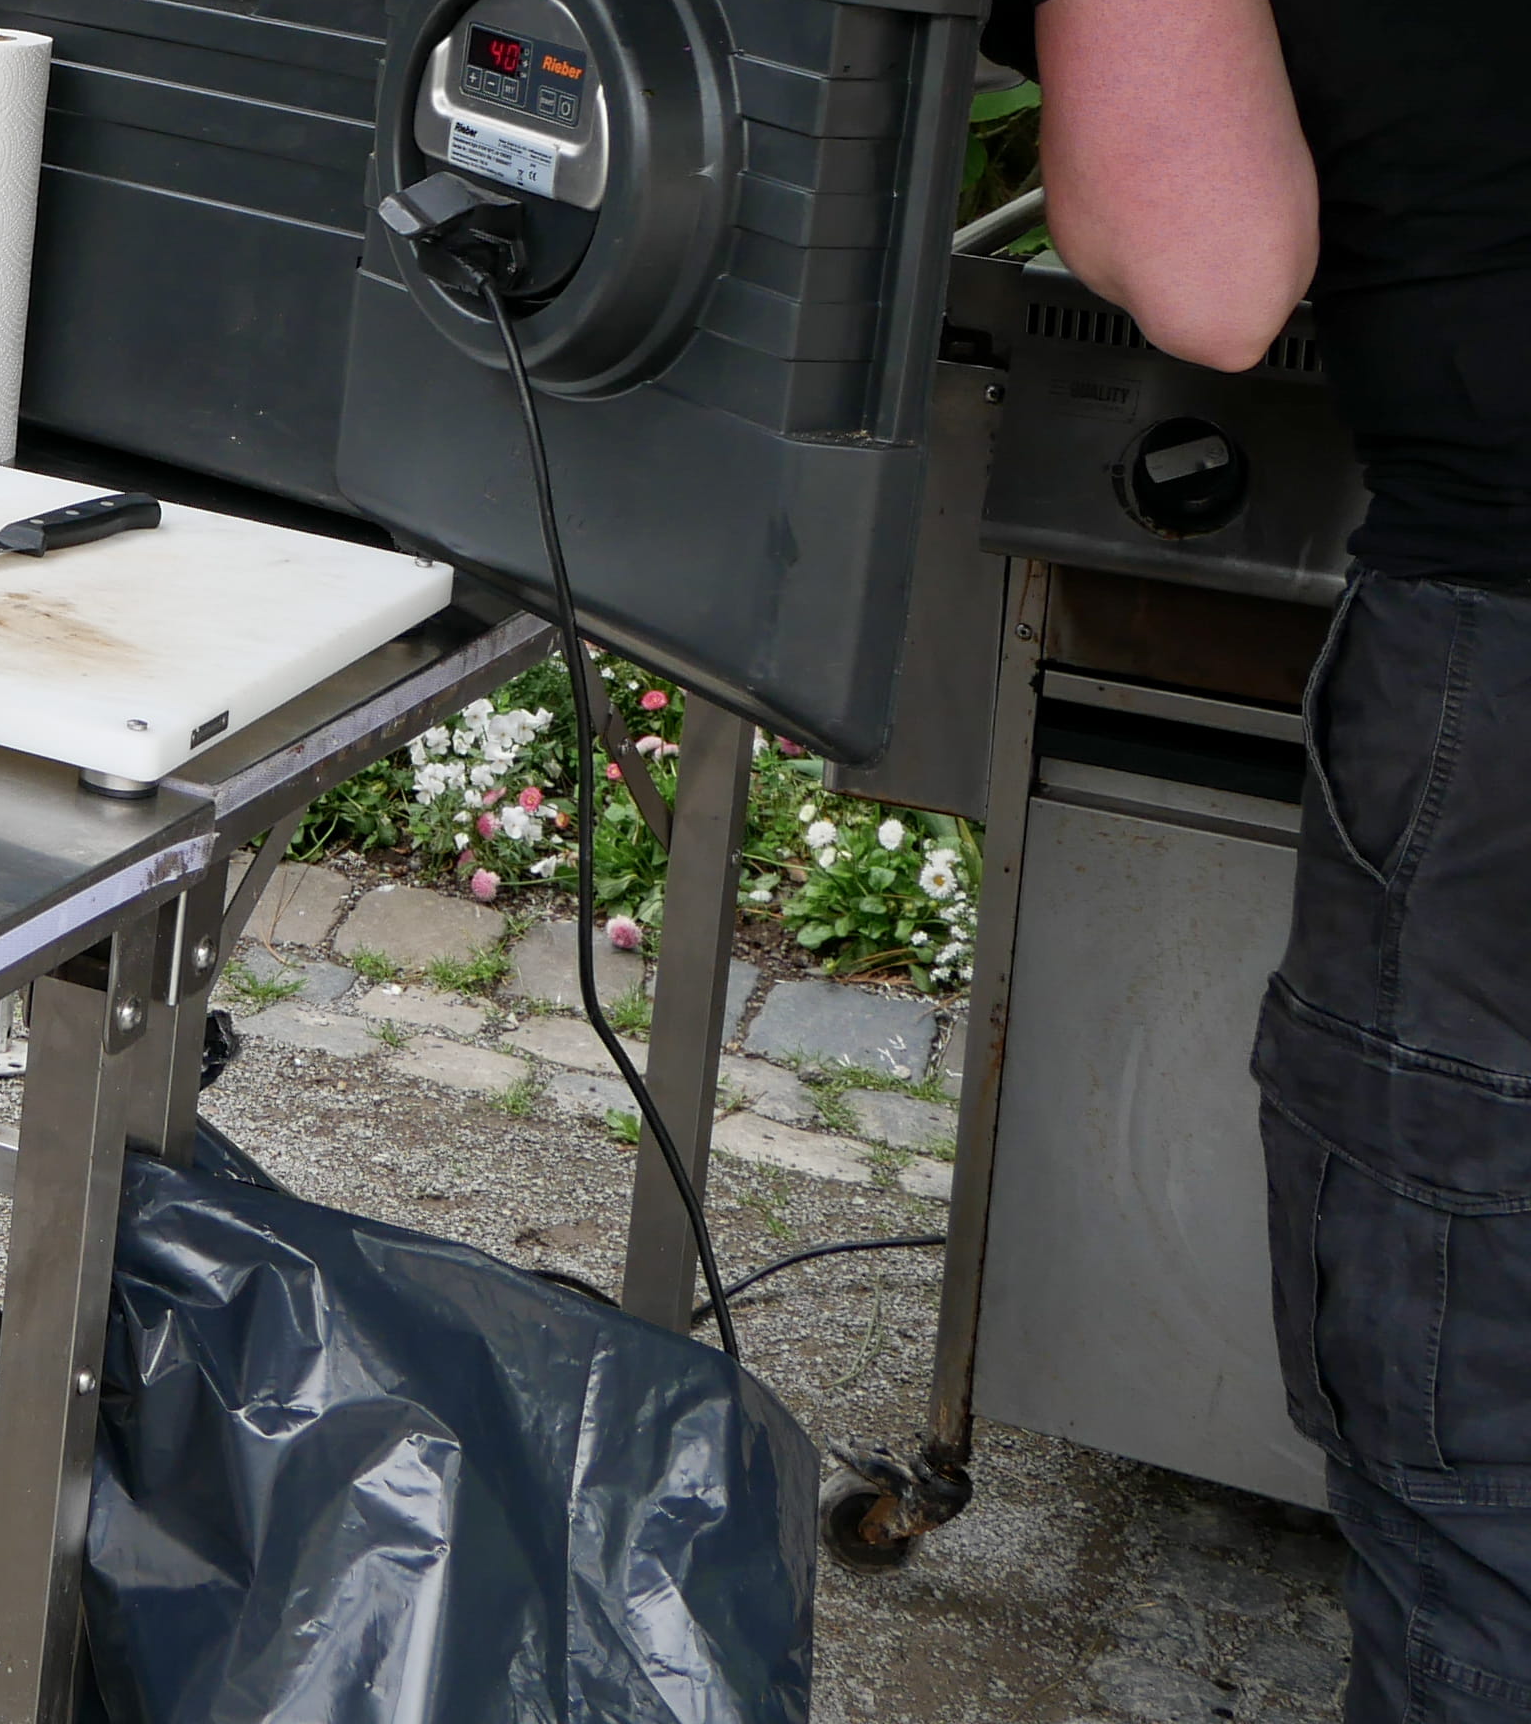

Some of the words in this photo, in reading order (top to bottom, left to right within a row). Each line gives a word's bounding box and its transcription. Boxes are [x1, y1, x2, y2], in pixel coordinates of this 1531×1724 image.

[490, 40, 521, 71] 40
[542, 55, 584, 80] Rieber
[454, 122, 478, 138] Rieber
